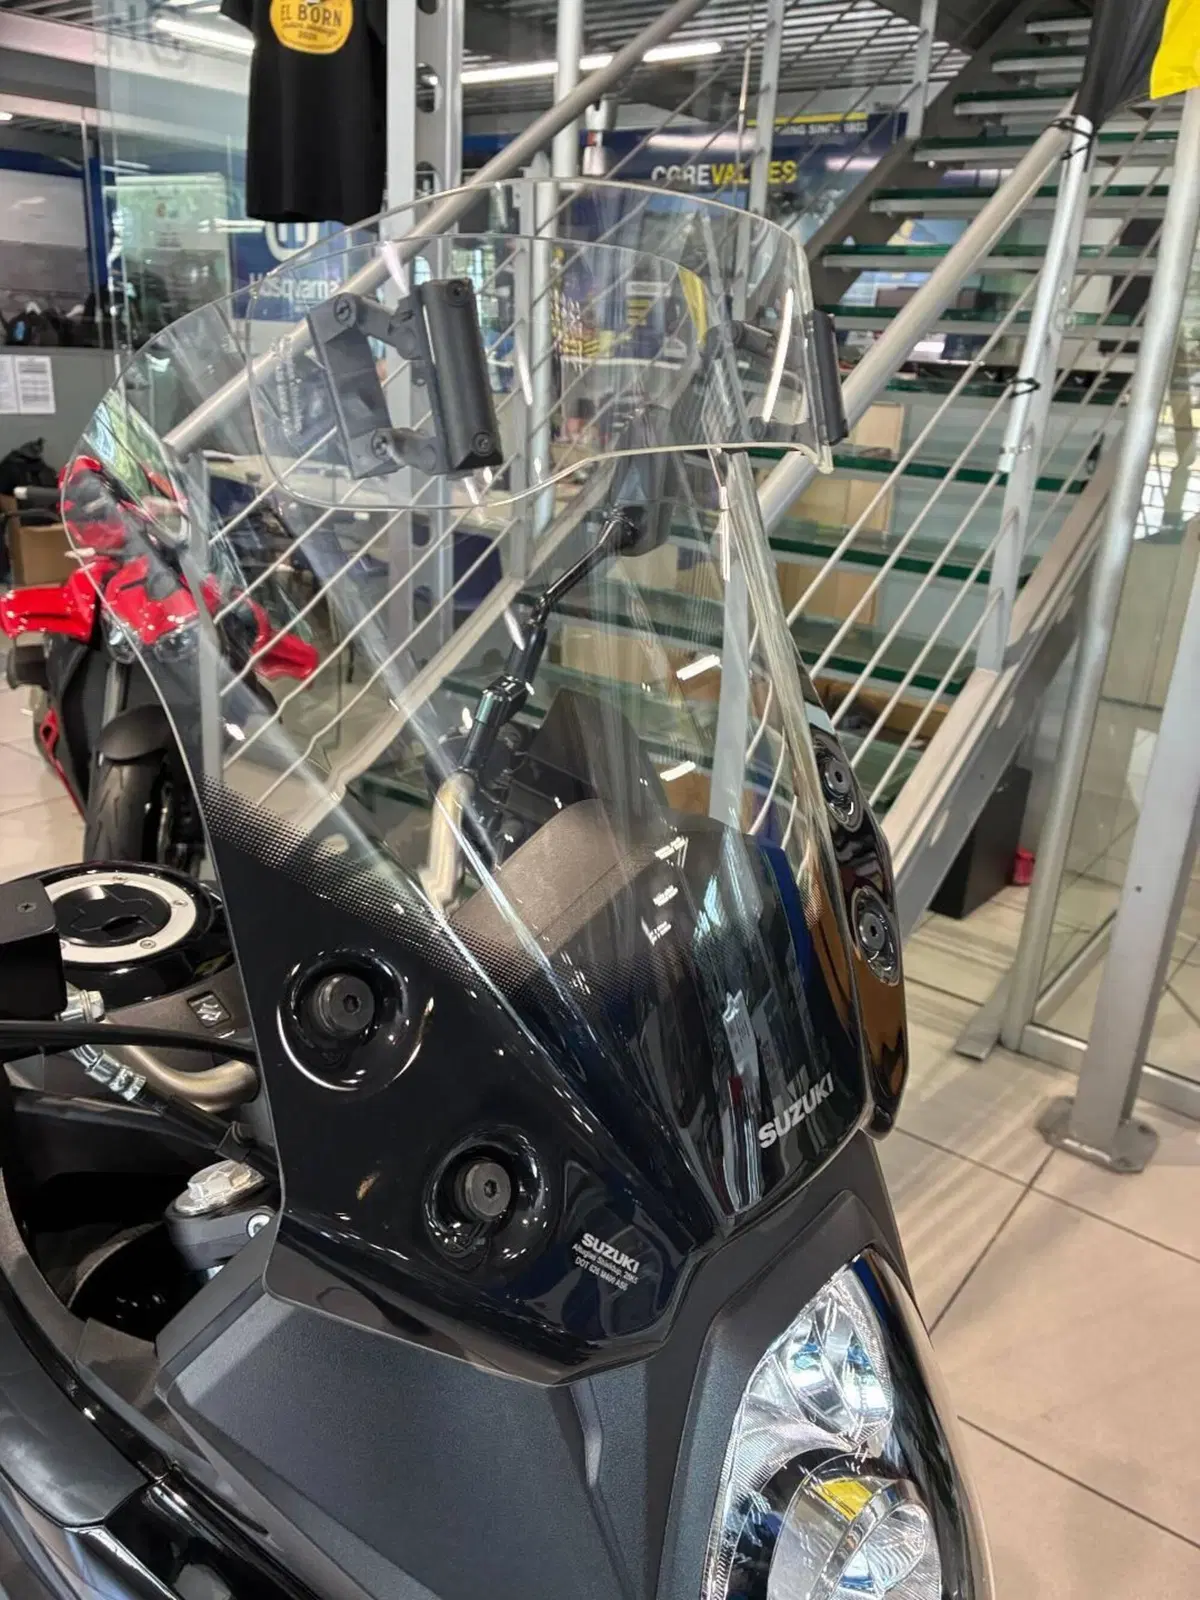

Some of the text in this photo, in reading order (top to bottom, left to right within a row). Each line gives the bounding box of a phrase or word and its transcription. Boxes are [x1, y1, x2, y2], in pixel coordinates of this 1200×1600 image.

[298, 4, 342, 27] BORN
[651, 160, 799, 186] COREVALES
[758, 1072, 834, 1149] SUZUKI
[574, 1255, 590, 1269] DOT
[581, 1232, 640, 1274] SUZUKI
